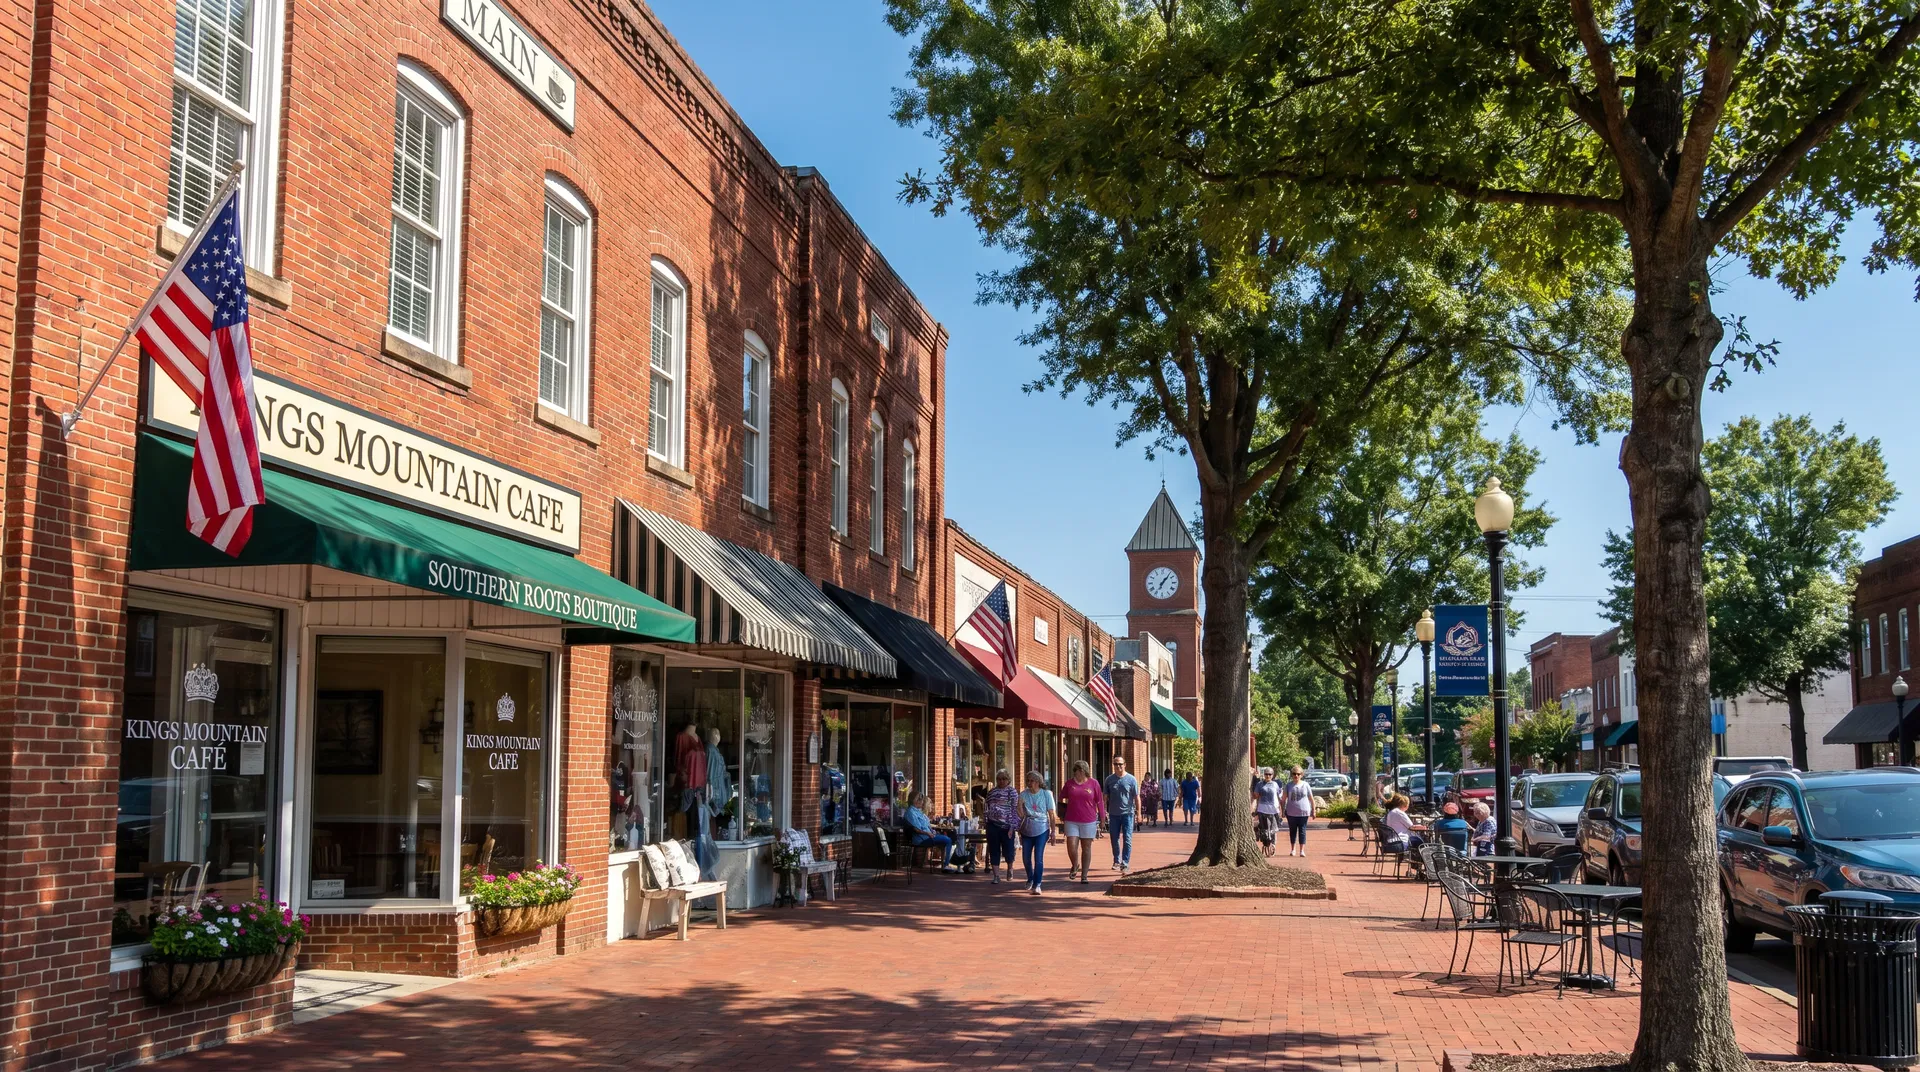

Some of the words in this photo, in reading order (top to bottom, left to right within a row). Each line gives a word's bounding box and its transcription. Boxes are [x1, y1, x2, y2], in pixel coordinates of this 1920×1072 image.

[461, 0, 539, 86] MAIN
[190, 390, 326, 456] NGS
[334, 420, 502, 513] MOUNTAIN
[507, 484, 564, 534] CAFE
[428, 560, 521, 605] SOUTHERN
[524, 583, 571, 615] ROOTS
[573, 595, 638, 631] BOUTIQUE
[125, 719, 180, 741] KINGS
[183, 722, 269, 743] MOUNTAIN
[466, 734, 495, 749] KINGS
[495, 735, 541, 750] MOUNTAIN
[170, 742, 227, 771] CAFÉ
[489, 750, 519, 770] CAFÉ
